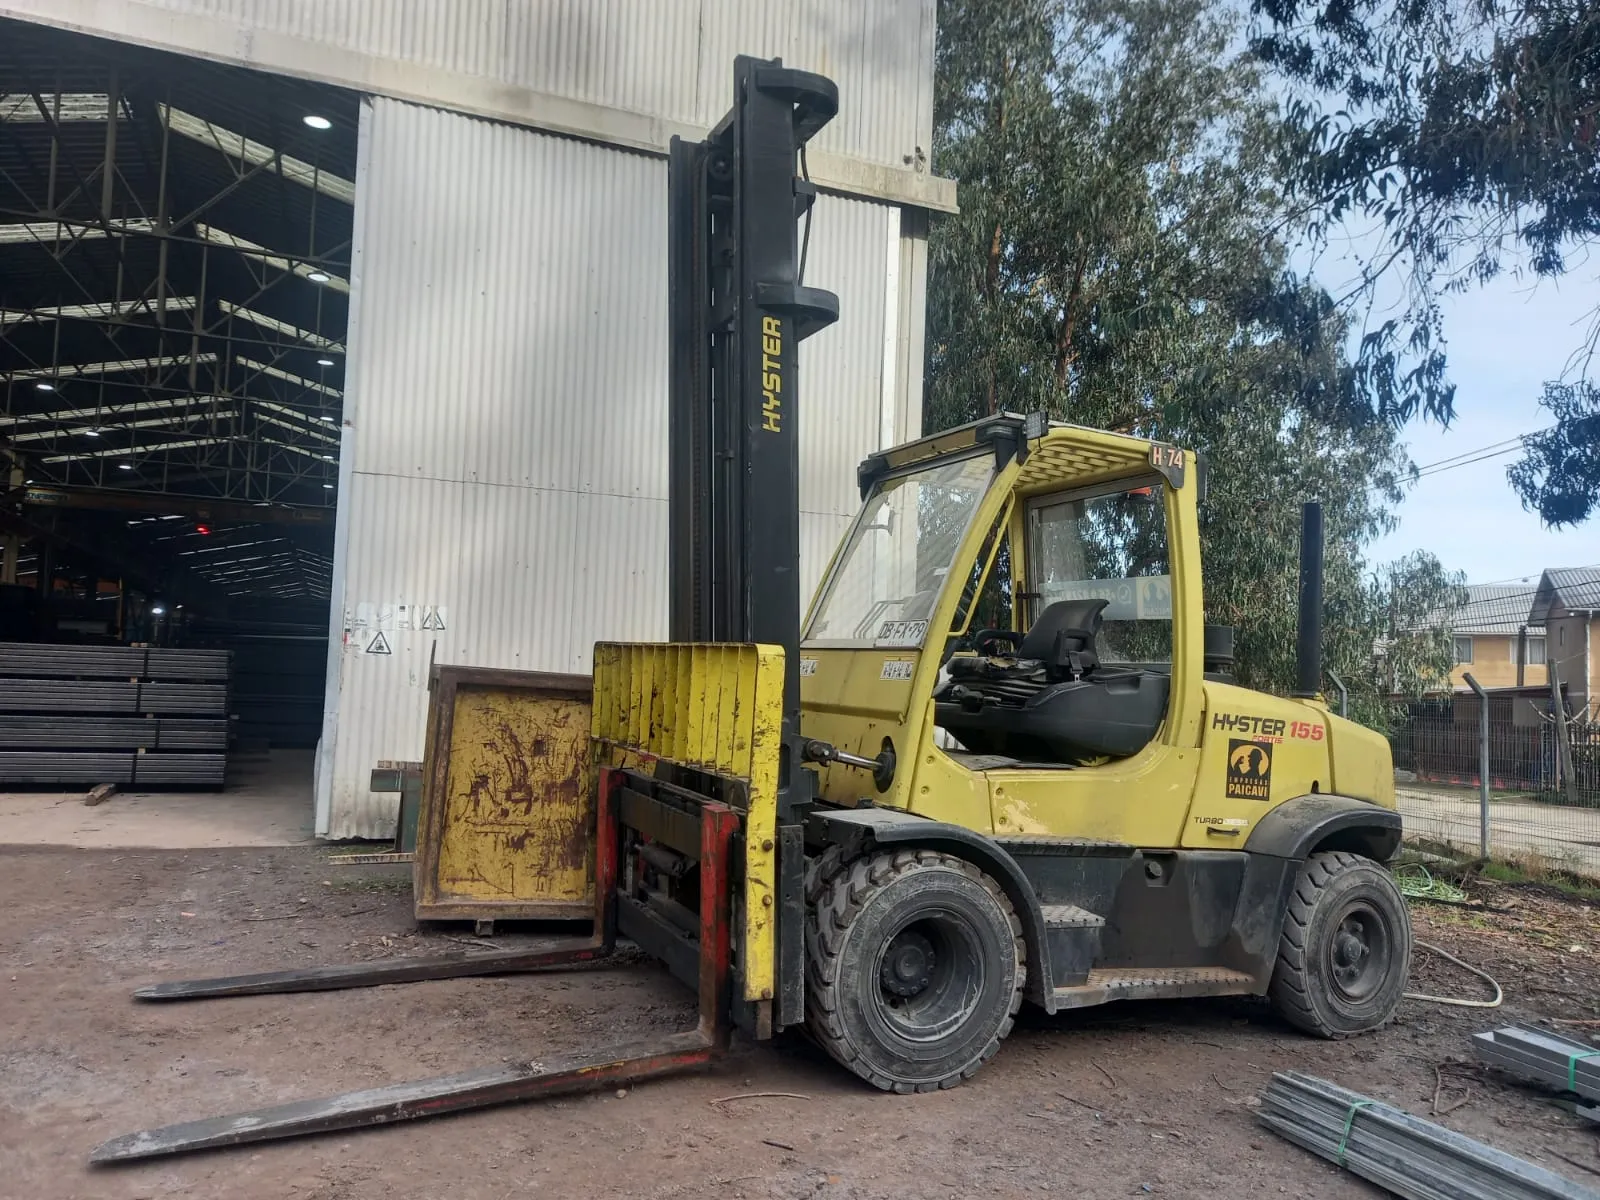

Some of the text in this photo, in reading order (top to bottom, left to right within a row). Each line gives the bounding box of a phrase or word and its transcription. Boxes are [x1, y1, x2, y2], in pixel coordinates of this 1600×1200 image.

[762, 316, 781, 433] HYSTER
[1212, 713, 1324, 741] HYSTER 155
[1194, 816, 1224, 825] TURBO
